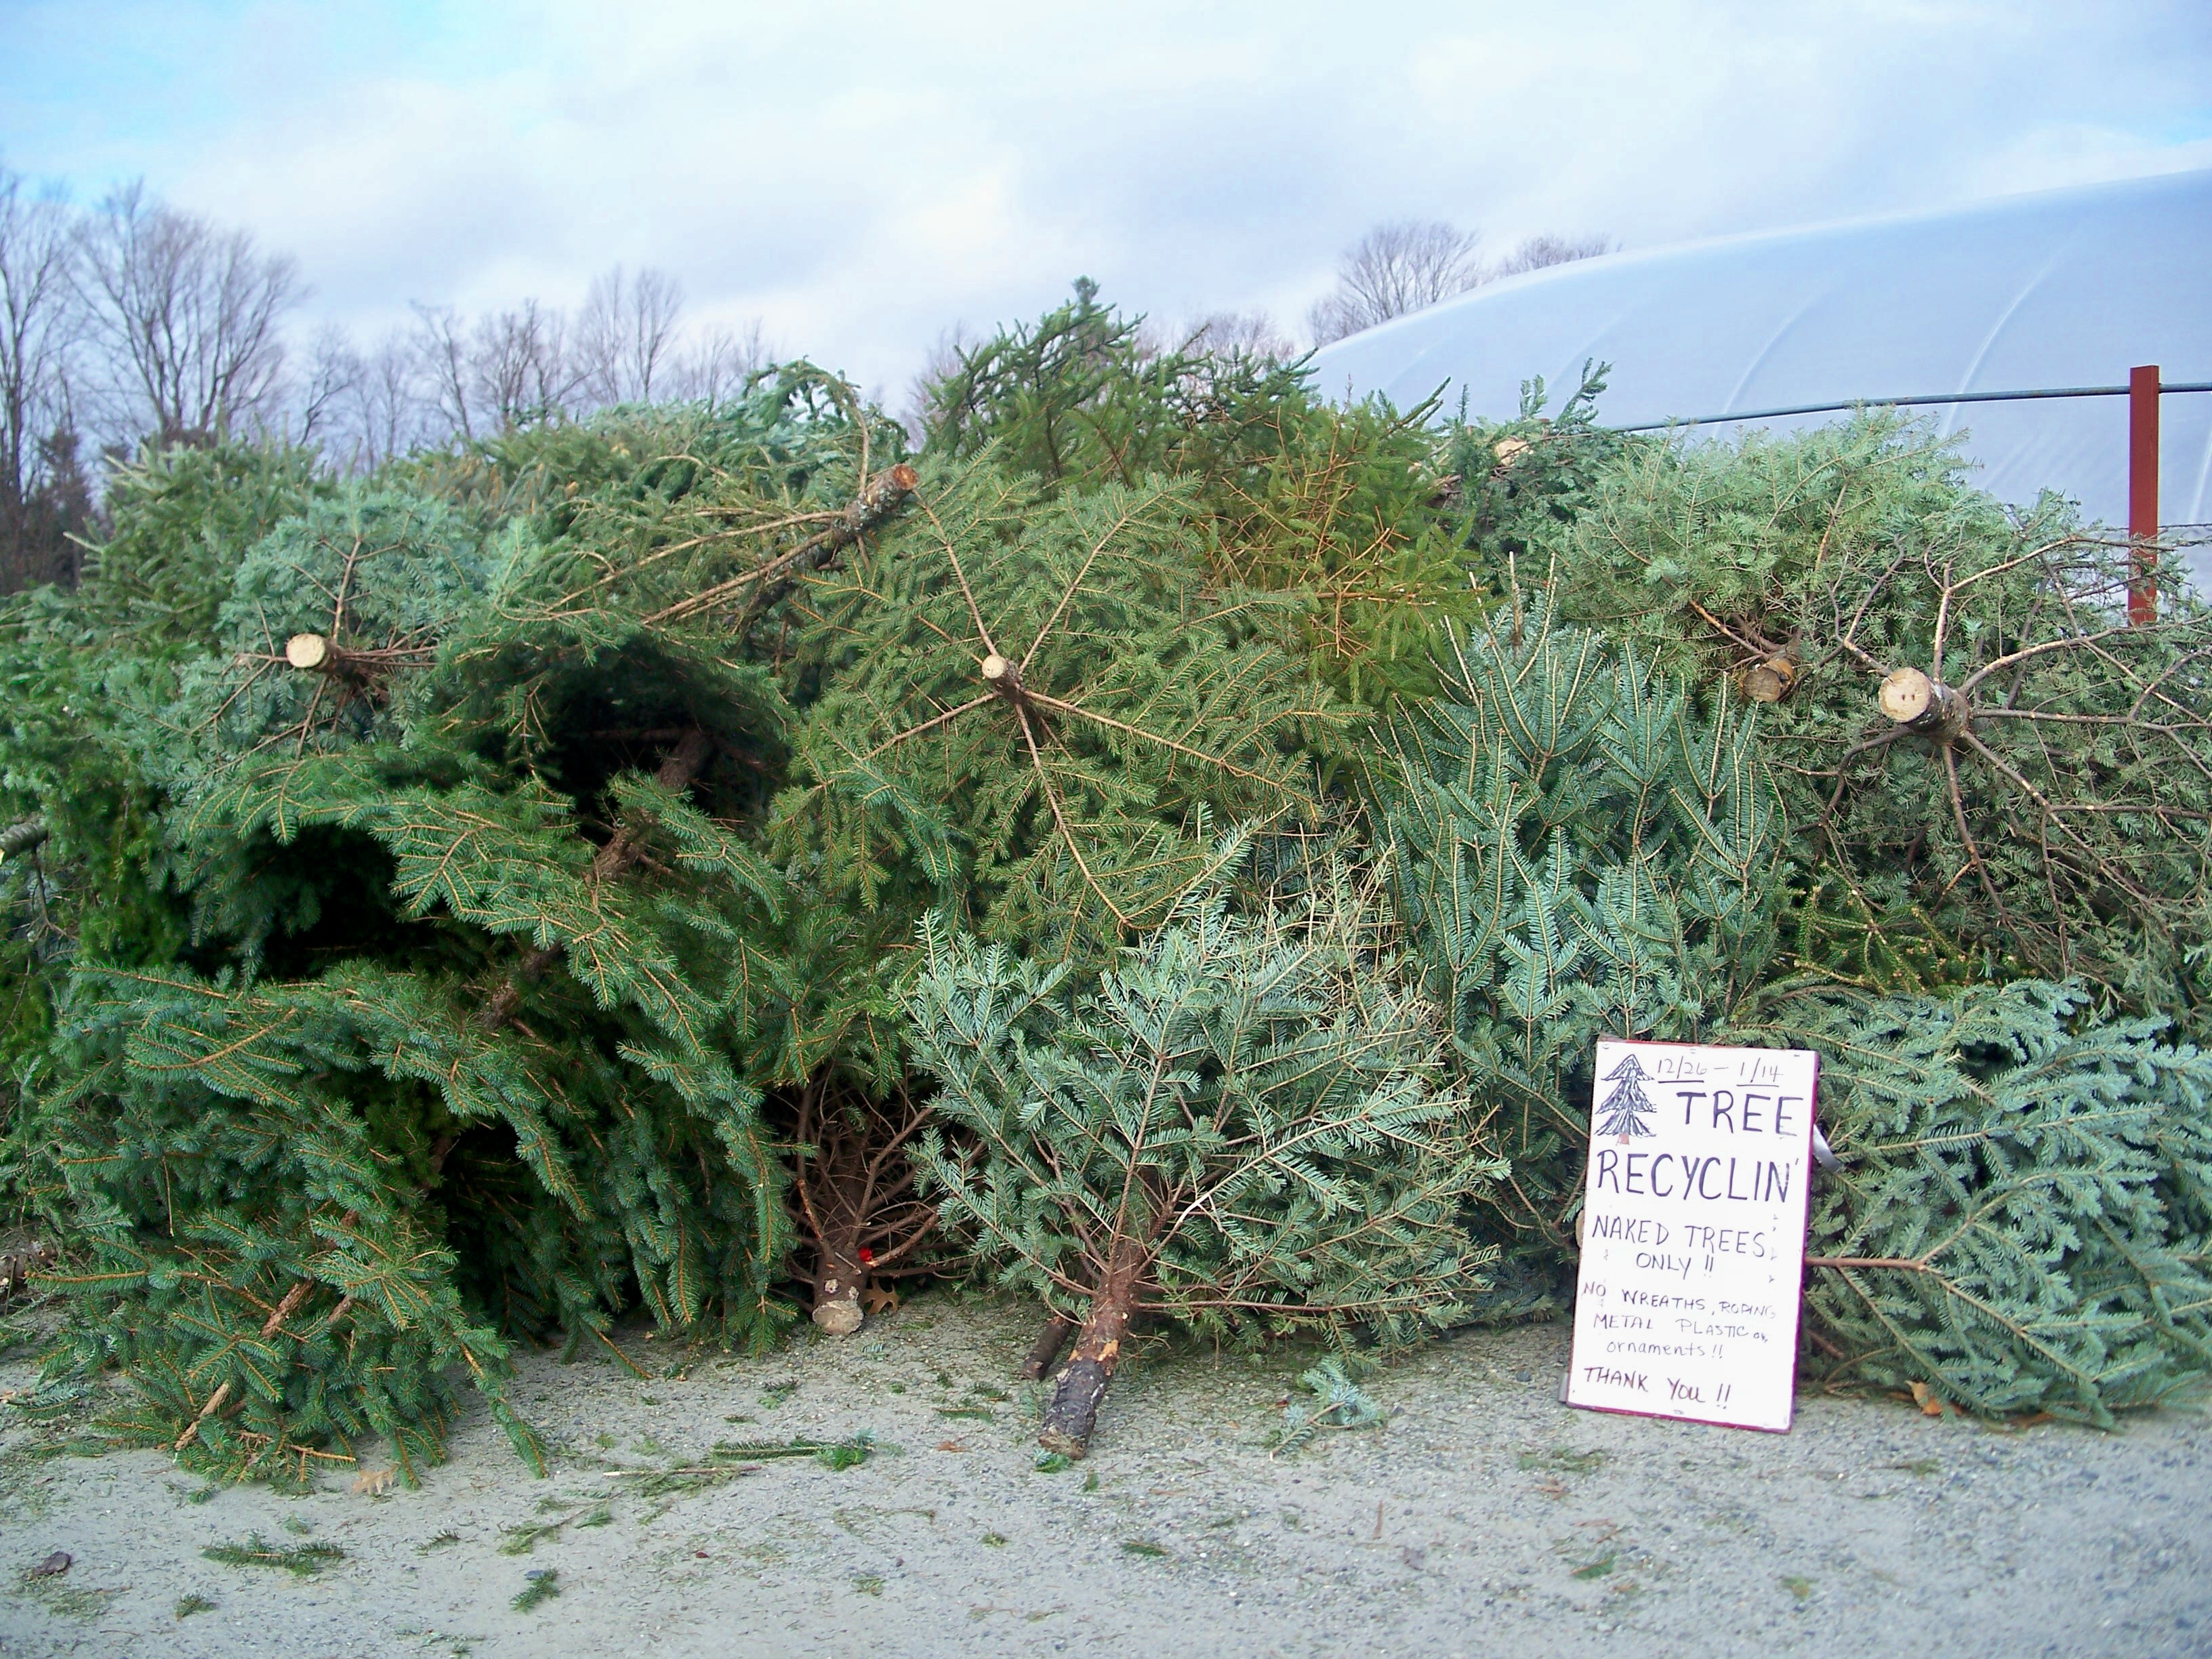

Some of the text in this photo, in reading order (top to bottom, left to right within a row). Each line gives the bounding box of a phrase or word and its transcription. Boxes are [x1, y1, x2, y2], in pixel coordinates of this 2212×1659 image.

[1677, 1090, 1804, 1136] TREE
[1592, 1215, 1765, 1257] NAKED TREES
[1636, 1252, 1692, 1280] ONLY
[1583, 1282, 1606, 1297] NO
[1593, 1313, 1654, 1330] METAL
[1675, 1318, 1749, 1338] PLASTIC
[1584, 1367, 1649, 1393] THANK
